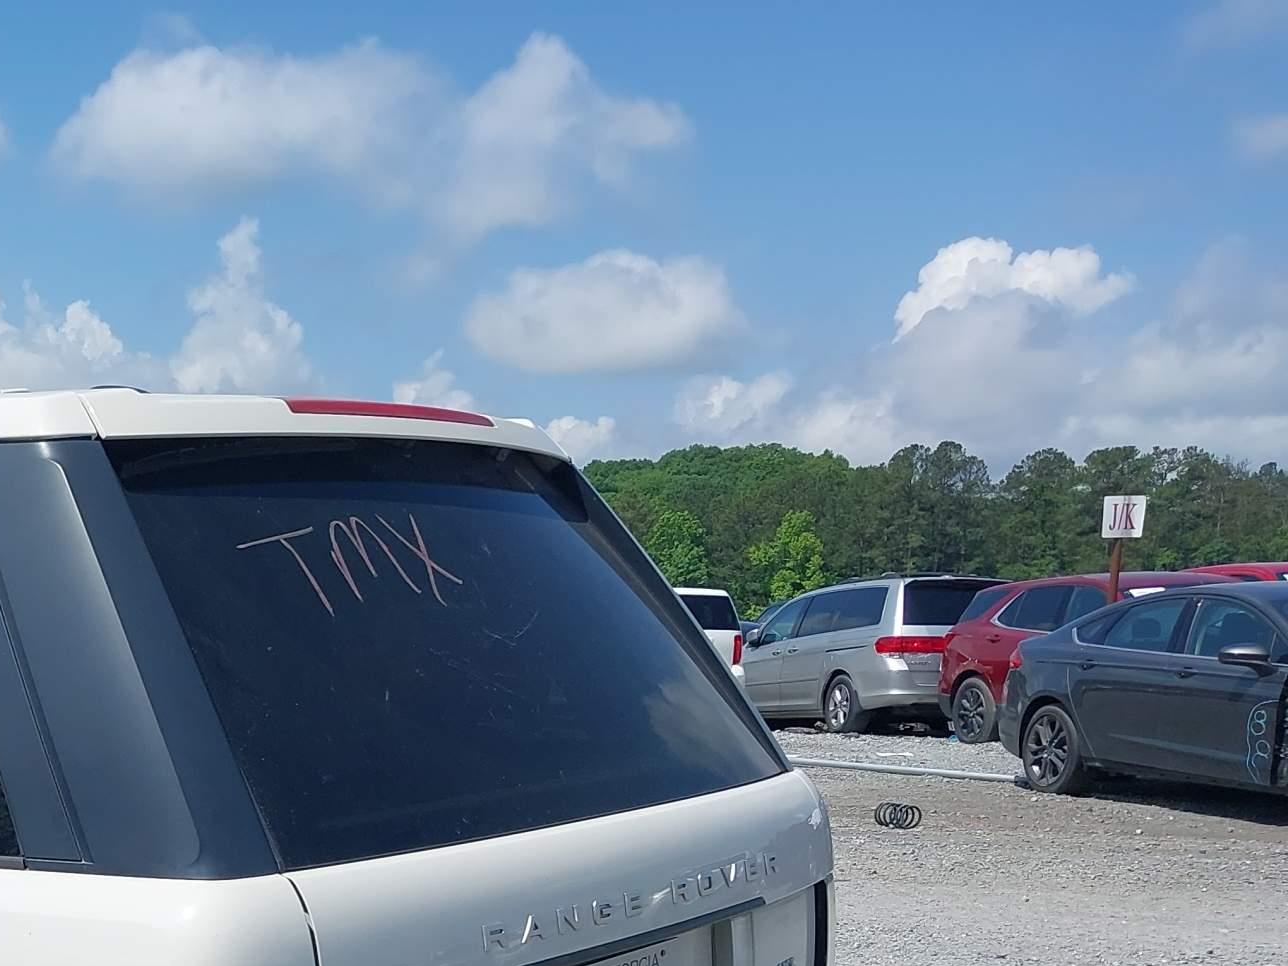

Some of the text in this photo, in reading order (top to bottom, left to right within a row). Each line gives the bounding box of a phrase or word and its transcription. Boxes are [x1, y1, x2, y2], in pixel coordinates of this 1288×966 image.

[236, 512, 464, 617] TMX
[1109, 503, 1138, 531] J/K
[481, 852, 779, 952] RANGE ROVER
